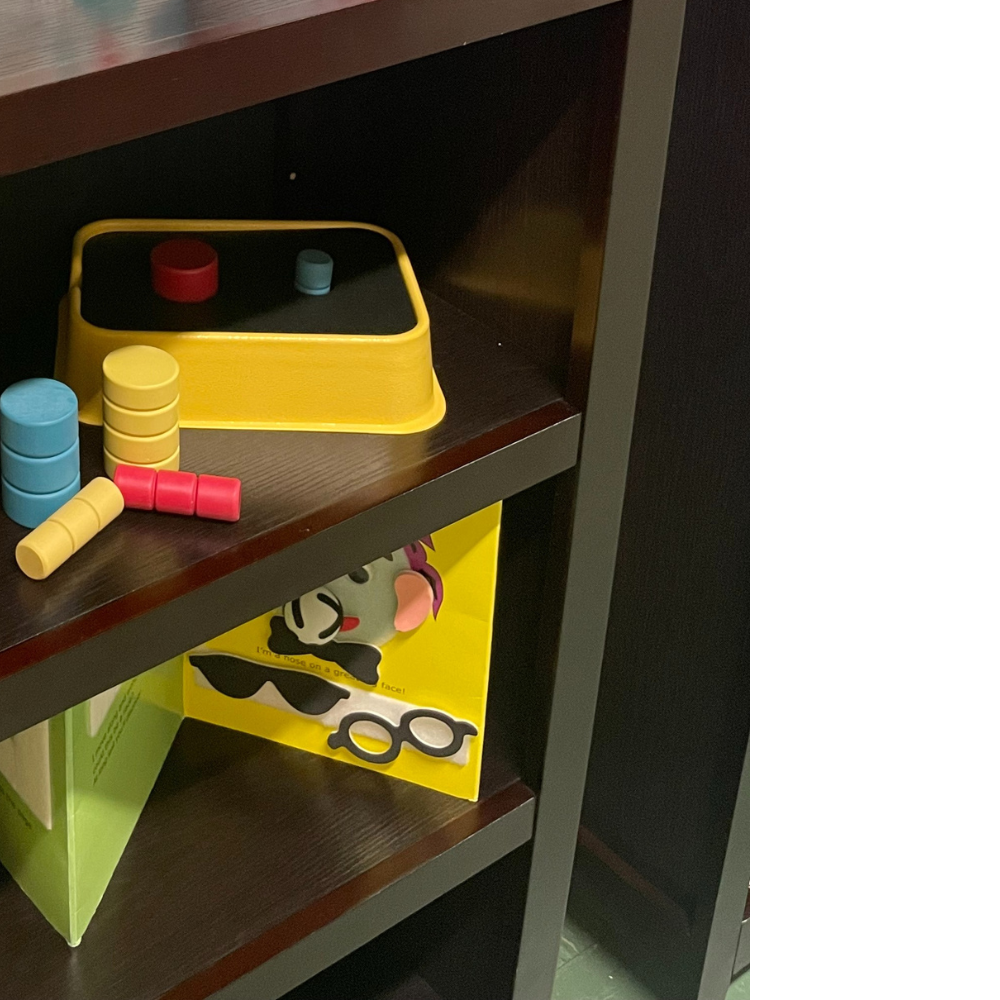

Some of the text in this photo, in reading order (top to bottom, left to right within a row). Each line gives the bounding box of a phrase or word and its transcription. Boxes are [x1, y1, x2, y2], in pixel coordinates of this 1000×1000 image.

[256, 645, 272, 657] I'm
[284, 655, 306, 667] nose
[309, 661, 322, 671] on
[324, 665, 331, 673] a
[381, 681, 406, 695] face!
